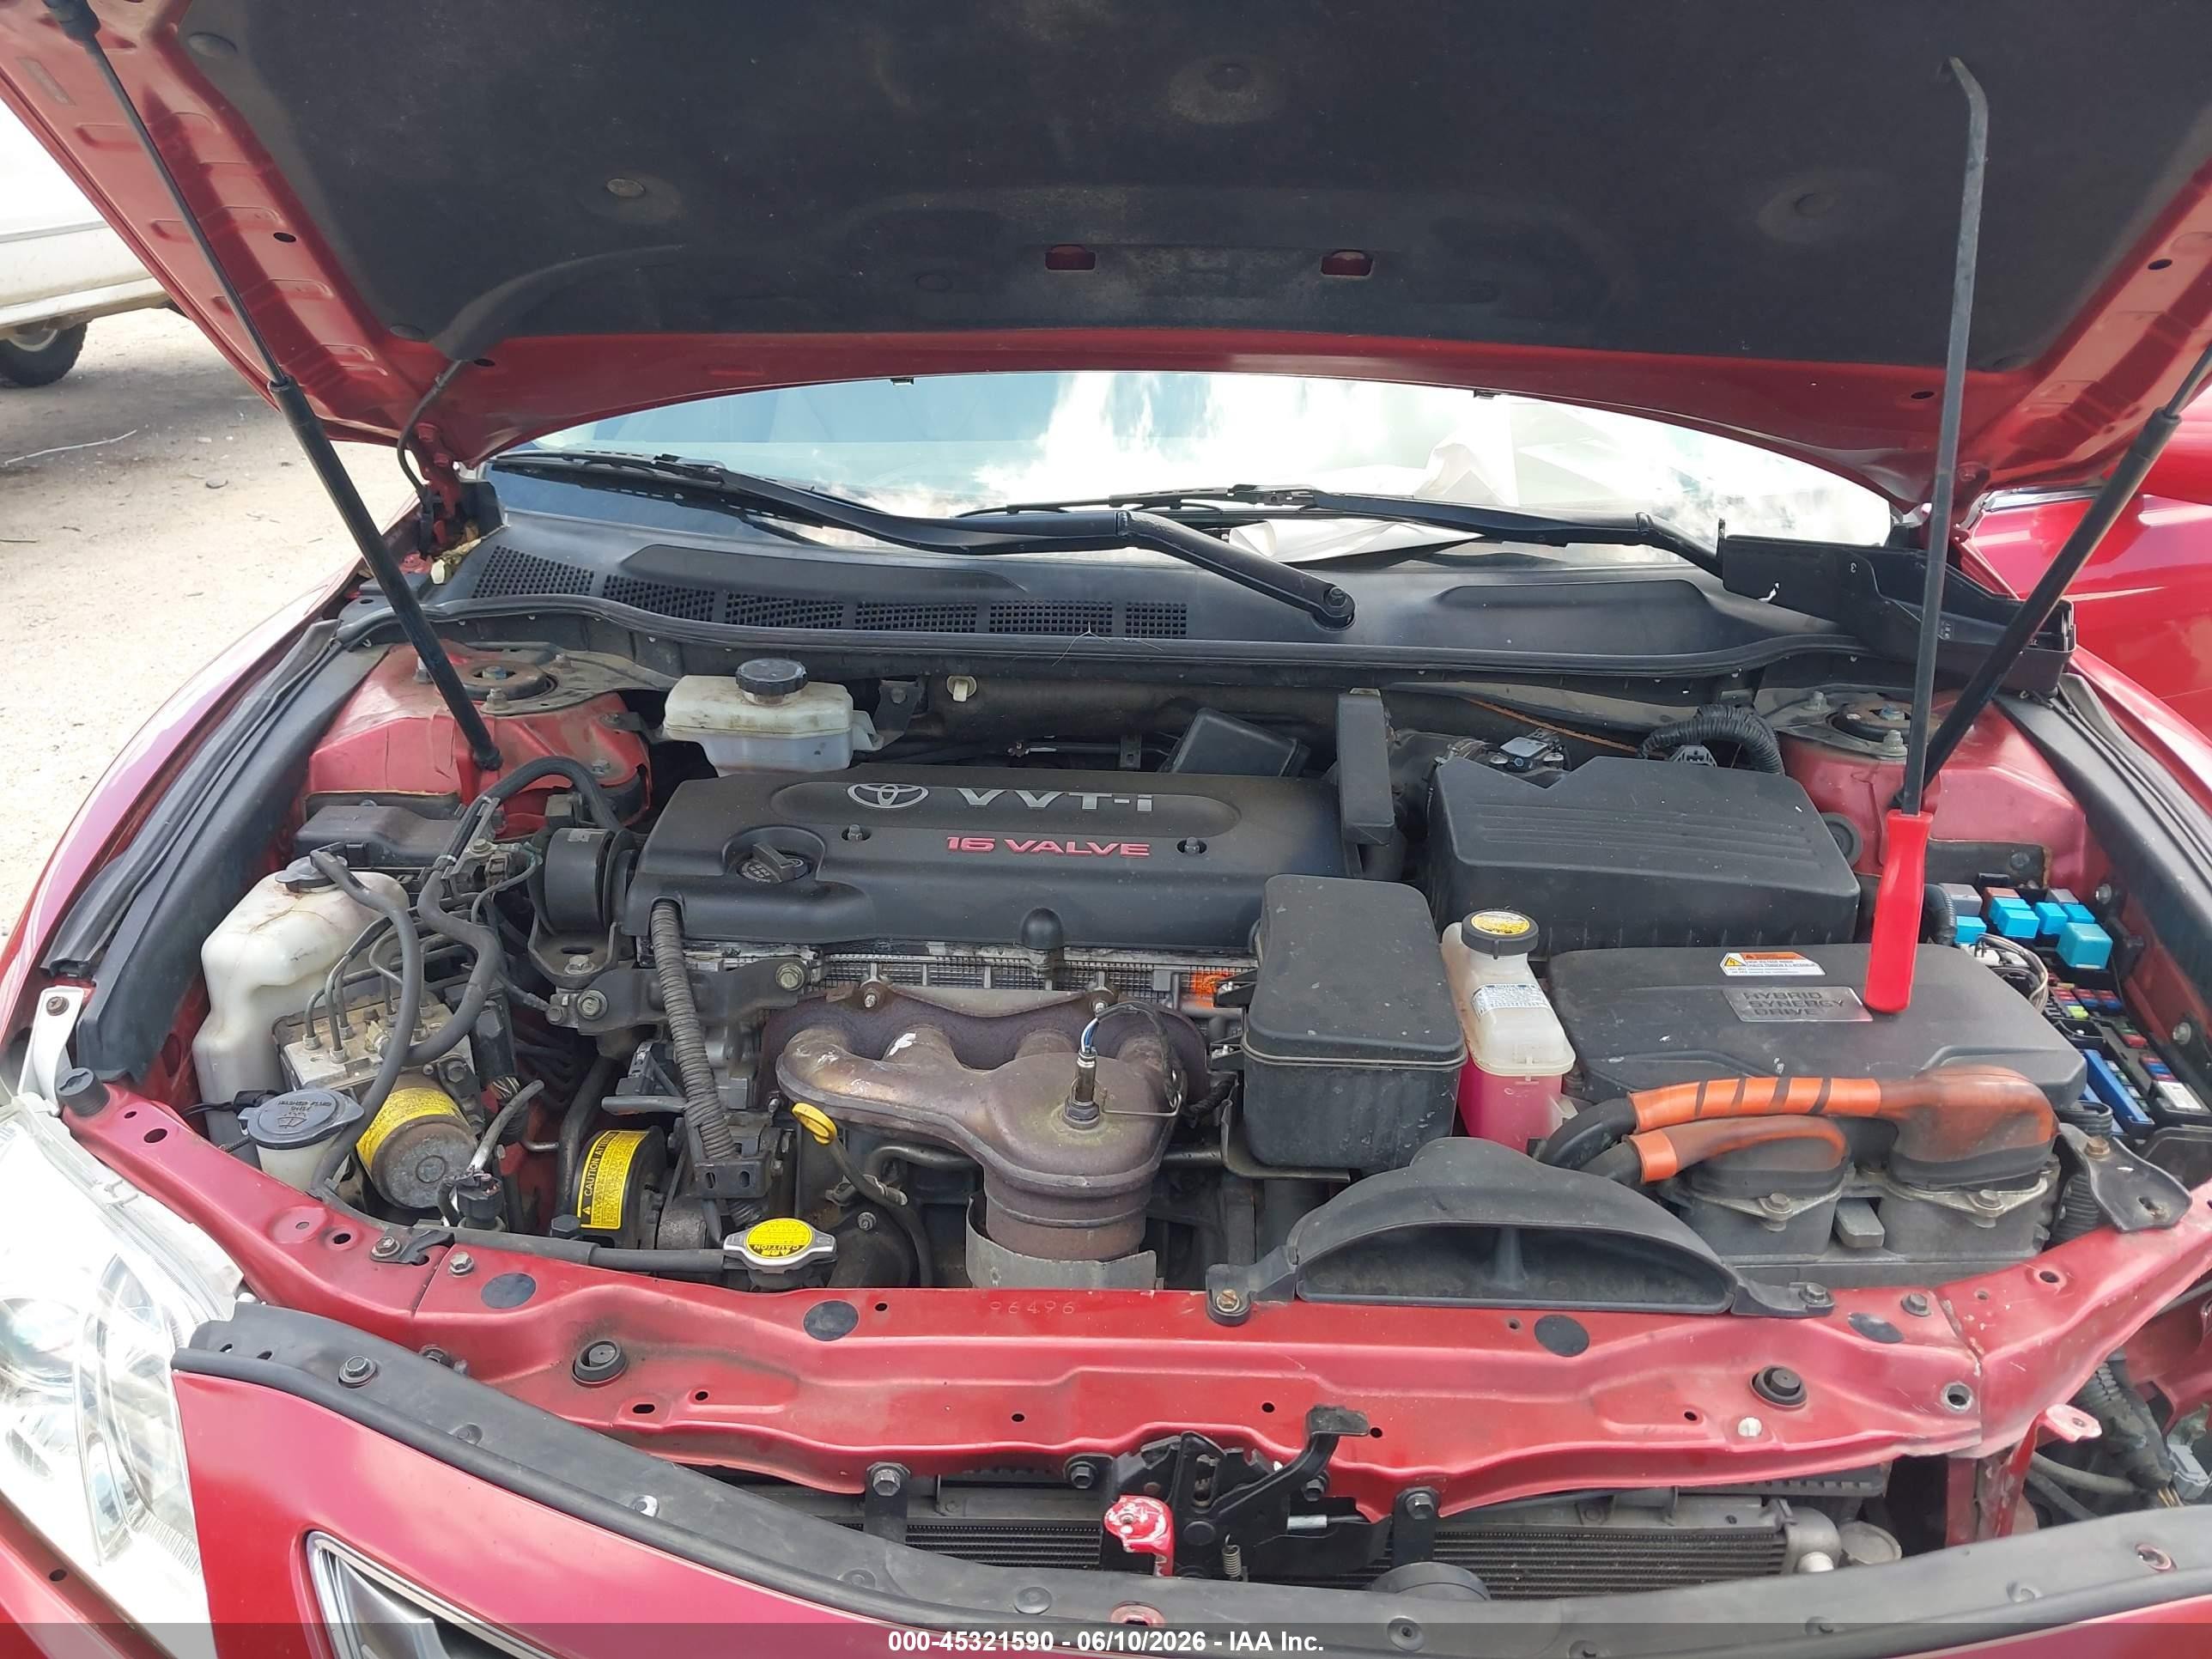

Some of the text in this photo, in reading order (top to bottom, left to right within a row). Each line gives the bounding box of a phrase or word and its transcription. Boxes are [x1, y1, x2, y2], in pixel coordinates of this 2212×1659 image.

[957, 787, 1153, 812] VVT-i
[946, 836, 1152, 858] 16 VALVE
[1743, 991, 1822, 1000] HYBRID
[1747, 1000, 1844, 1008] SYNERGY
[584, 1158, 601, 1197] CAUTION
